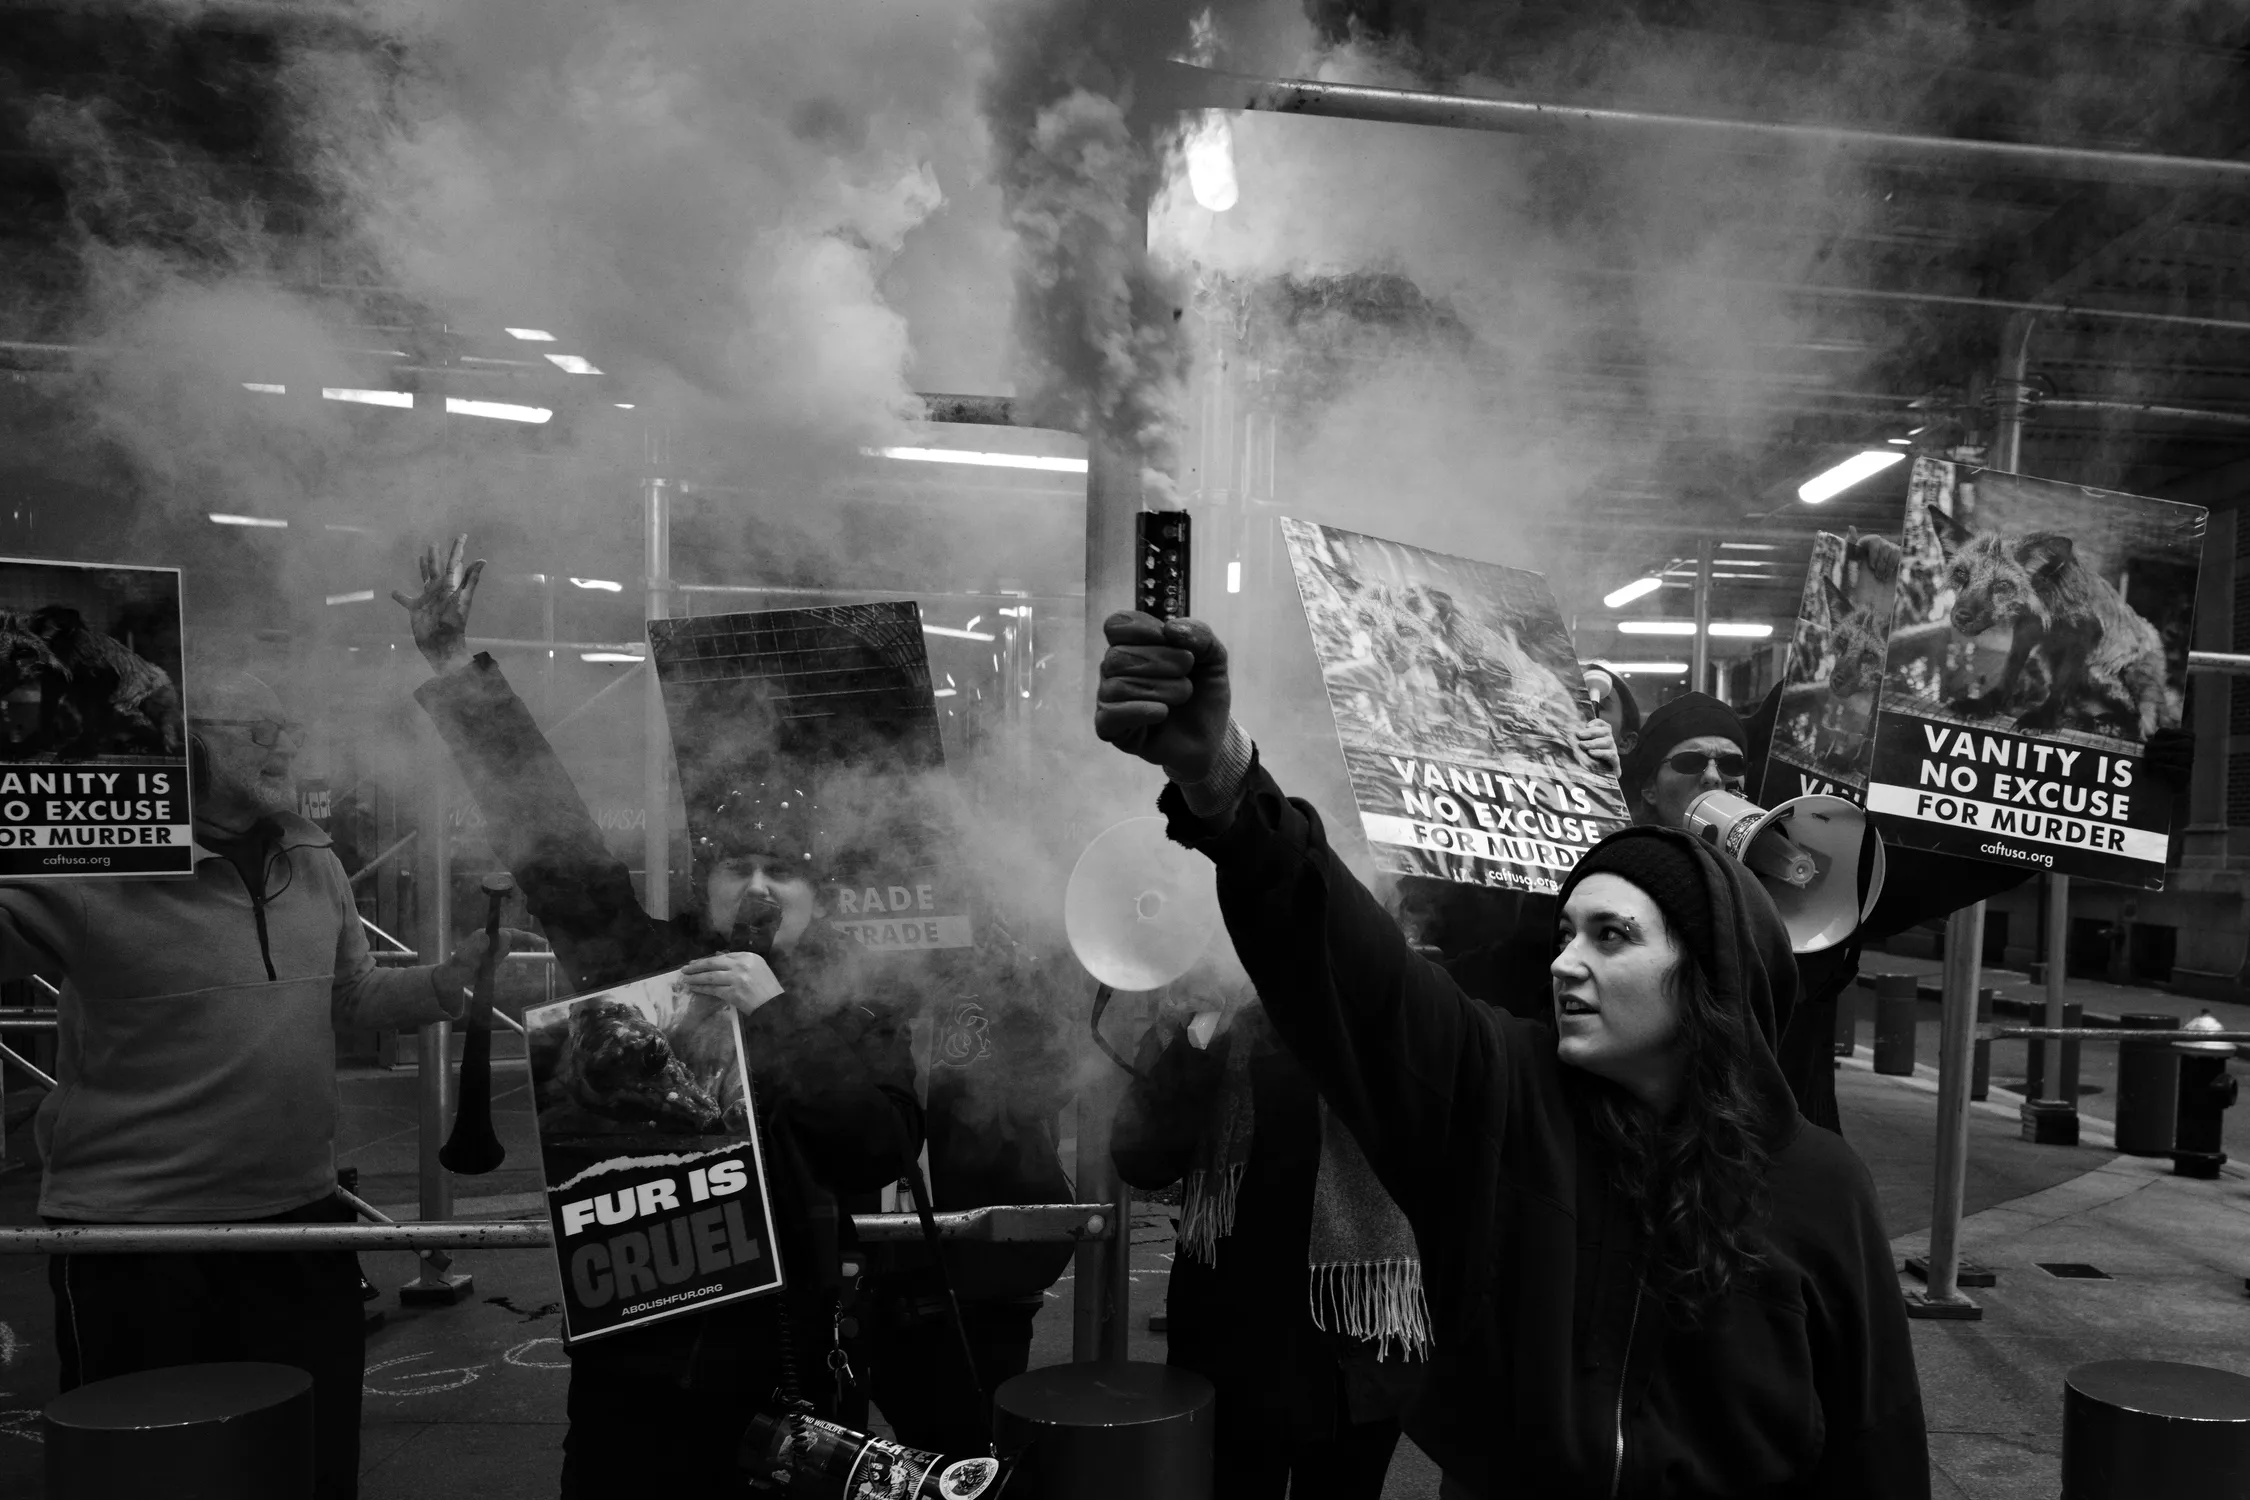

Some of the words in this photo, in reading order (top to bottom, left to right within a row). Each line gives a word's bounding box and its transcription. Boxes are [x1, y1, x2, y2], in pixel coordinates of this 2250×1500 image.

[1923, 724, 2081, 778] VANITY
[2097, 756, 2133, 788] IS
[0, 772, 120, 795] ANITY
[138, 772, 171, 795] IS
[1389, 756, 1538, 805] VANITY
[1555, 784, 1592, 815] IS
[1919, 759, 1978, 793] NO
[1993, 773, 2130, 821] EXCUSE
[3, 800, 31, 822] O
[46, 800, 171, 821] EXCUSE
[1401, 789, 1460, 823] NO
[1472, 801, 1602, 844] EXCUSE
[1917, 794, 1978, 826] FOR
[1990, 809, 2126, 852] MURDER
[0, 827, 37, 846] OR
[49, 827, 172, 846] MURDER
[1409, 823, 1476, 852] FOR
[1486, 835, 1589, 868] MURD
[1980, 841, 2054, 868] caftusa.org
[42, 853, 112, 868] caftusa.org
[1488, 868, 1558, 890] caftusa.org
[837, 884, 935, 914] RADE
[561, 1177, 680, 1237] FUR
[688, 1159, 748, 1204] IS
[571, 1200, 760, 1309] CRUEL
[621, 1283, 724, 1317] ABOLISHFUR.ORG
